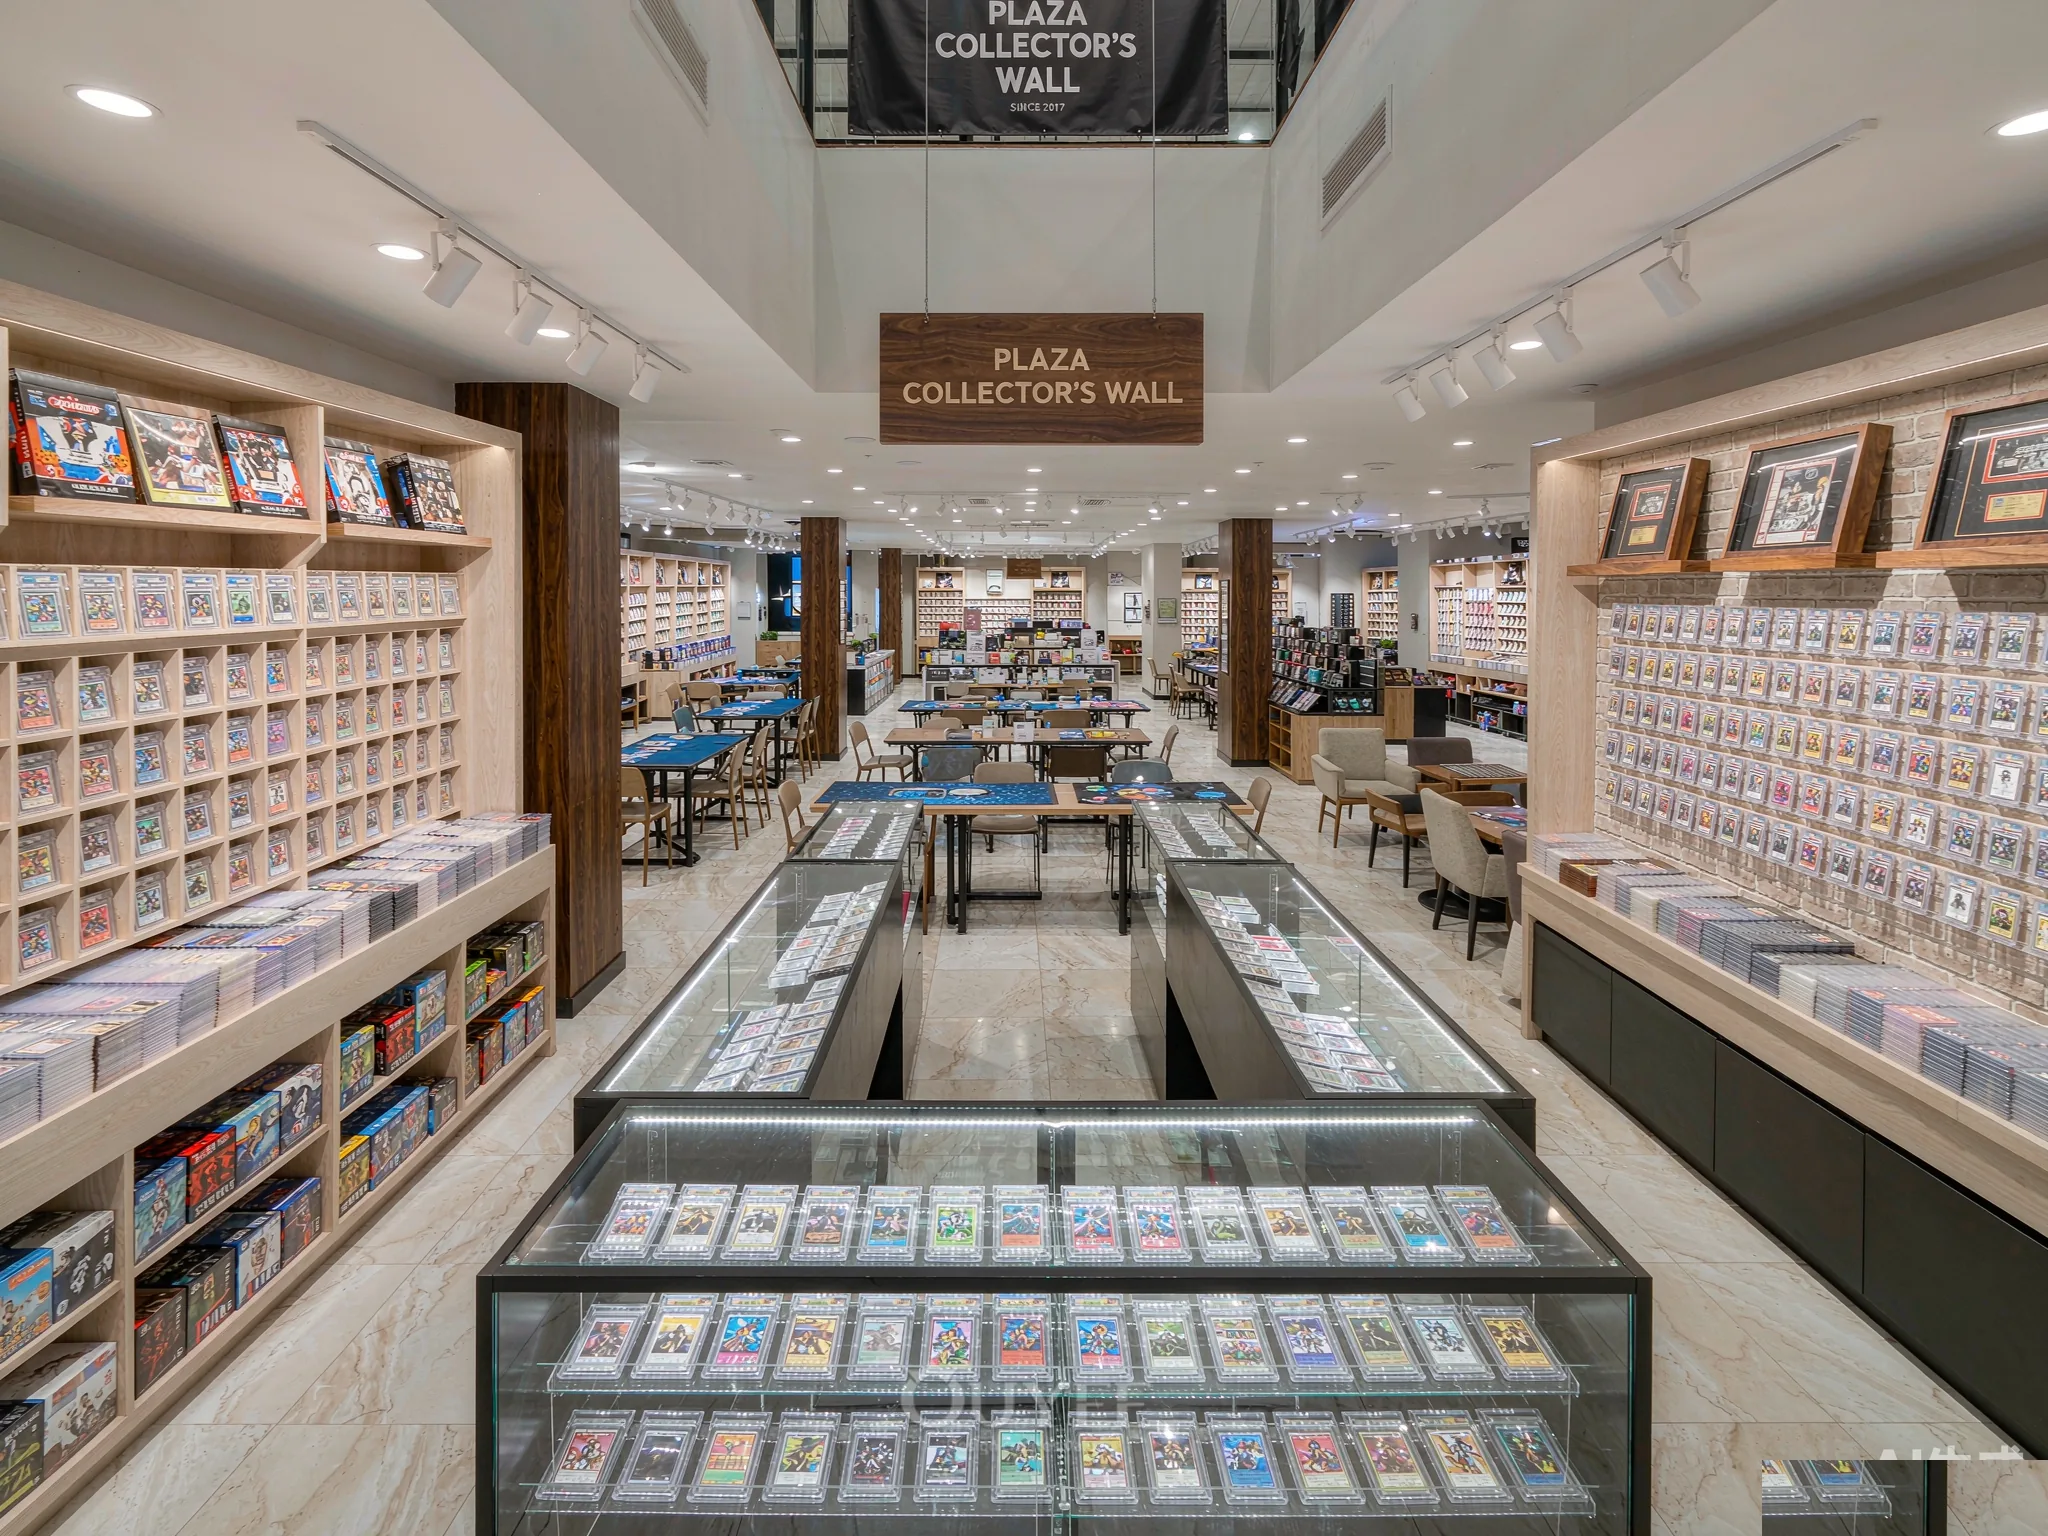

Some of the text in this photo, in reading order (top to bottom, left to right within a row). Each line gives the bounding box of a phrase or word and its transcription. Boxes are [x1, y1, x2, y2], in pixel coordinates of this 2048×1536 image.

[988, 0, 1088, 26] PLAZA
[935, 32, 1137, 59] COLLECTOR'S
[995, 66, 1081, 94] WALL
[1043, 102, 1066, 112] 2017
[994, 347, 1090, 371] PLAZA
[903, 381, 1184, 404] COLLECTOR'S WALL
